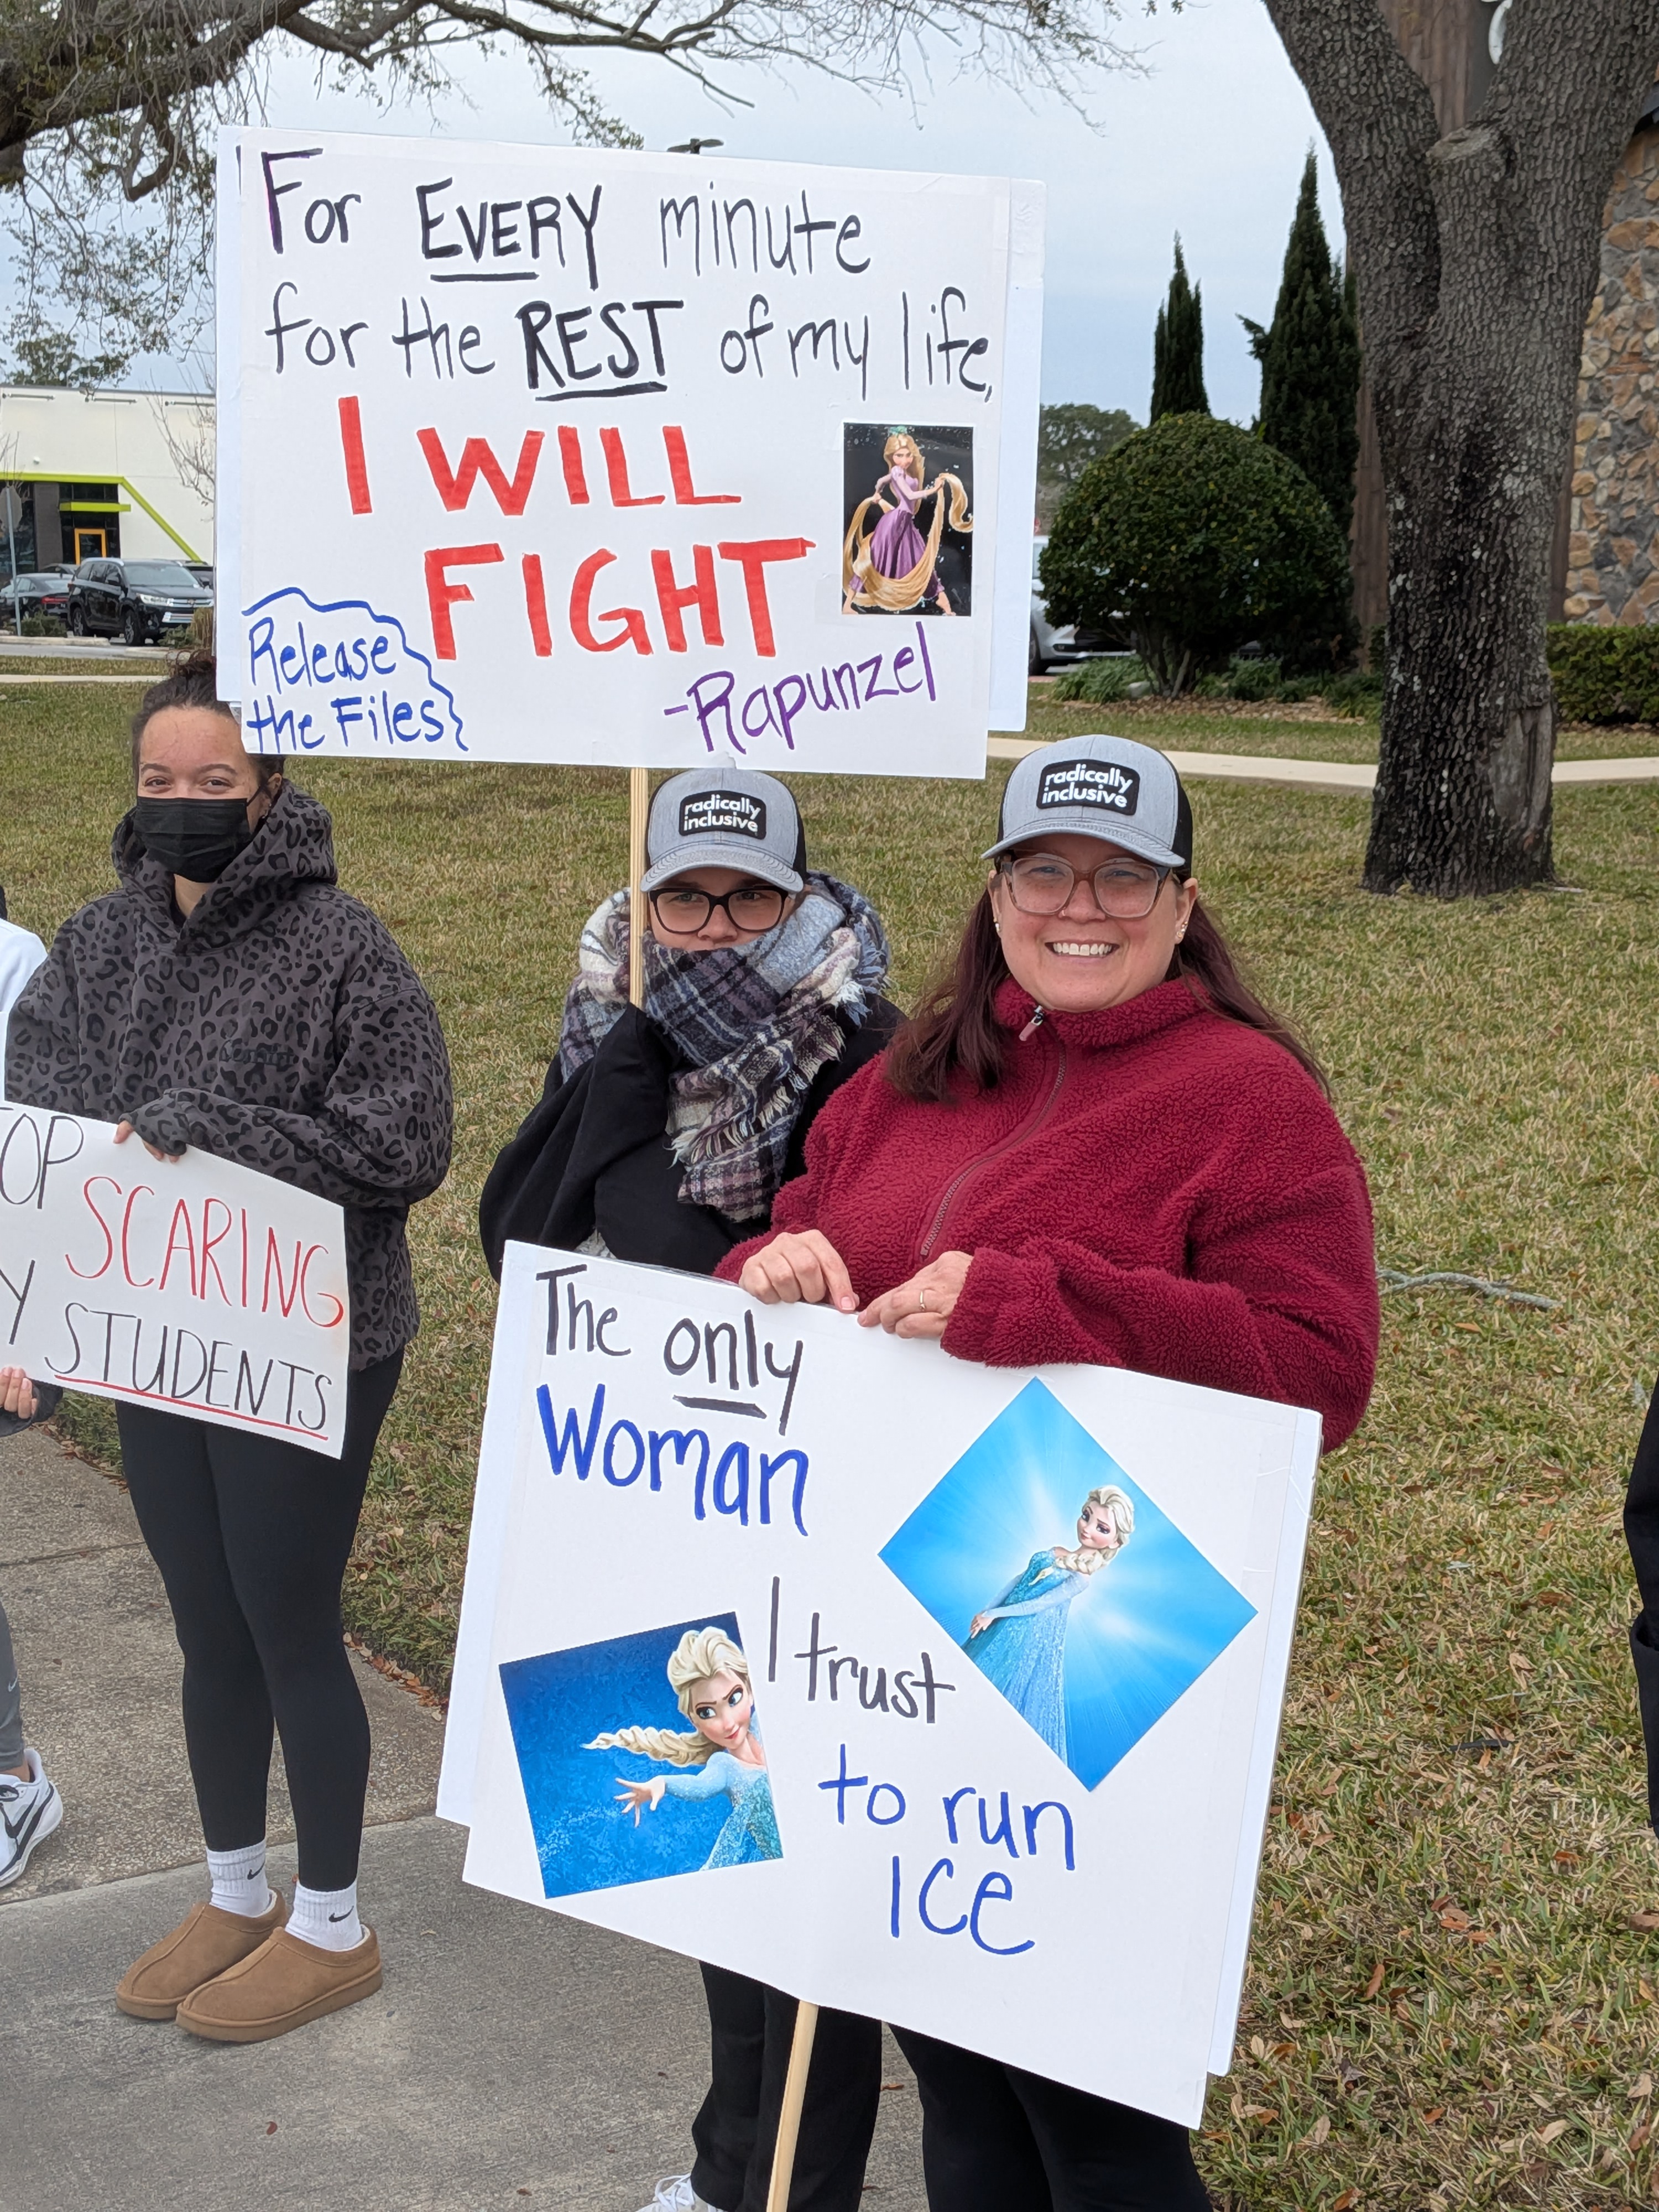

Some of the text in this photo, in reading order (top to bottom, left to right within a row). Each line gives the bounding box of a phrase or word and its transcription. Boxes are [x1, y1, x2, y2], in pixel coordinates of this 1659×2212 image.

[260, 147, 871, 290] For EVERY minute
[264, 282, 993, 402] for the REST of my life,
[338, 395, 742, 516] I WILL
[248, 617, 397, 695] Release
[424, 537, 817, 661] FIGHT
[246, 690, 444, 753] the Files
[1045, 763, 1133, 794] radically
[683, 810, 758, 832] inclusive
[685, 794, 761, 820] radically
[1042, 781, 1128, 808] inclusive
[0, 1107, 344, 1328] OP SCARING
[44, 1302, 332, 1430] STUDENTS
[535, 1264, 804, 1435] The only
[536, 1383, 810, 1537] Woman
[768, 1575, 957, 1724] I trust
[817, 1743, 1076, 1871] to run
